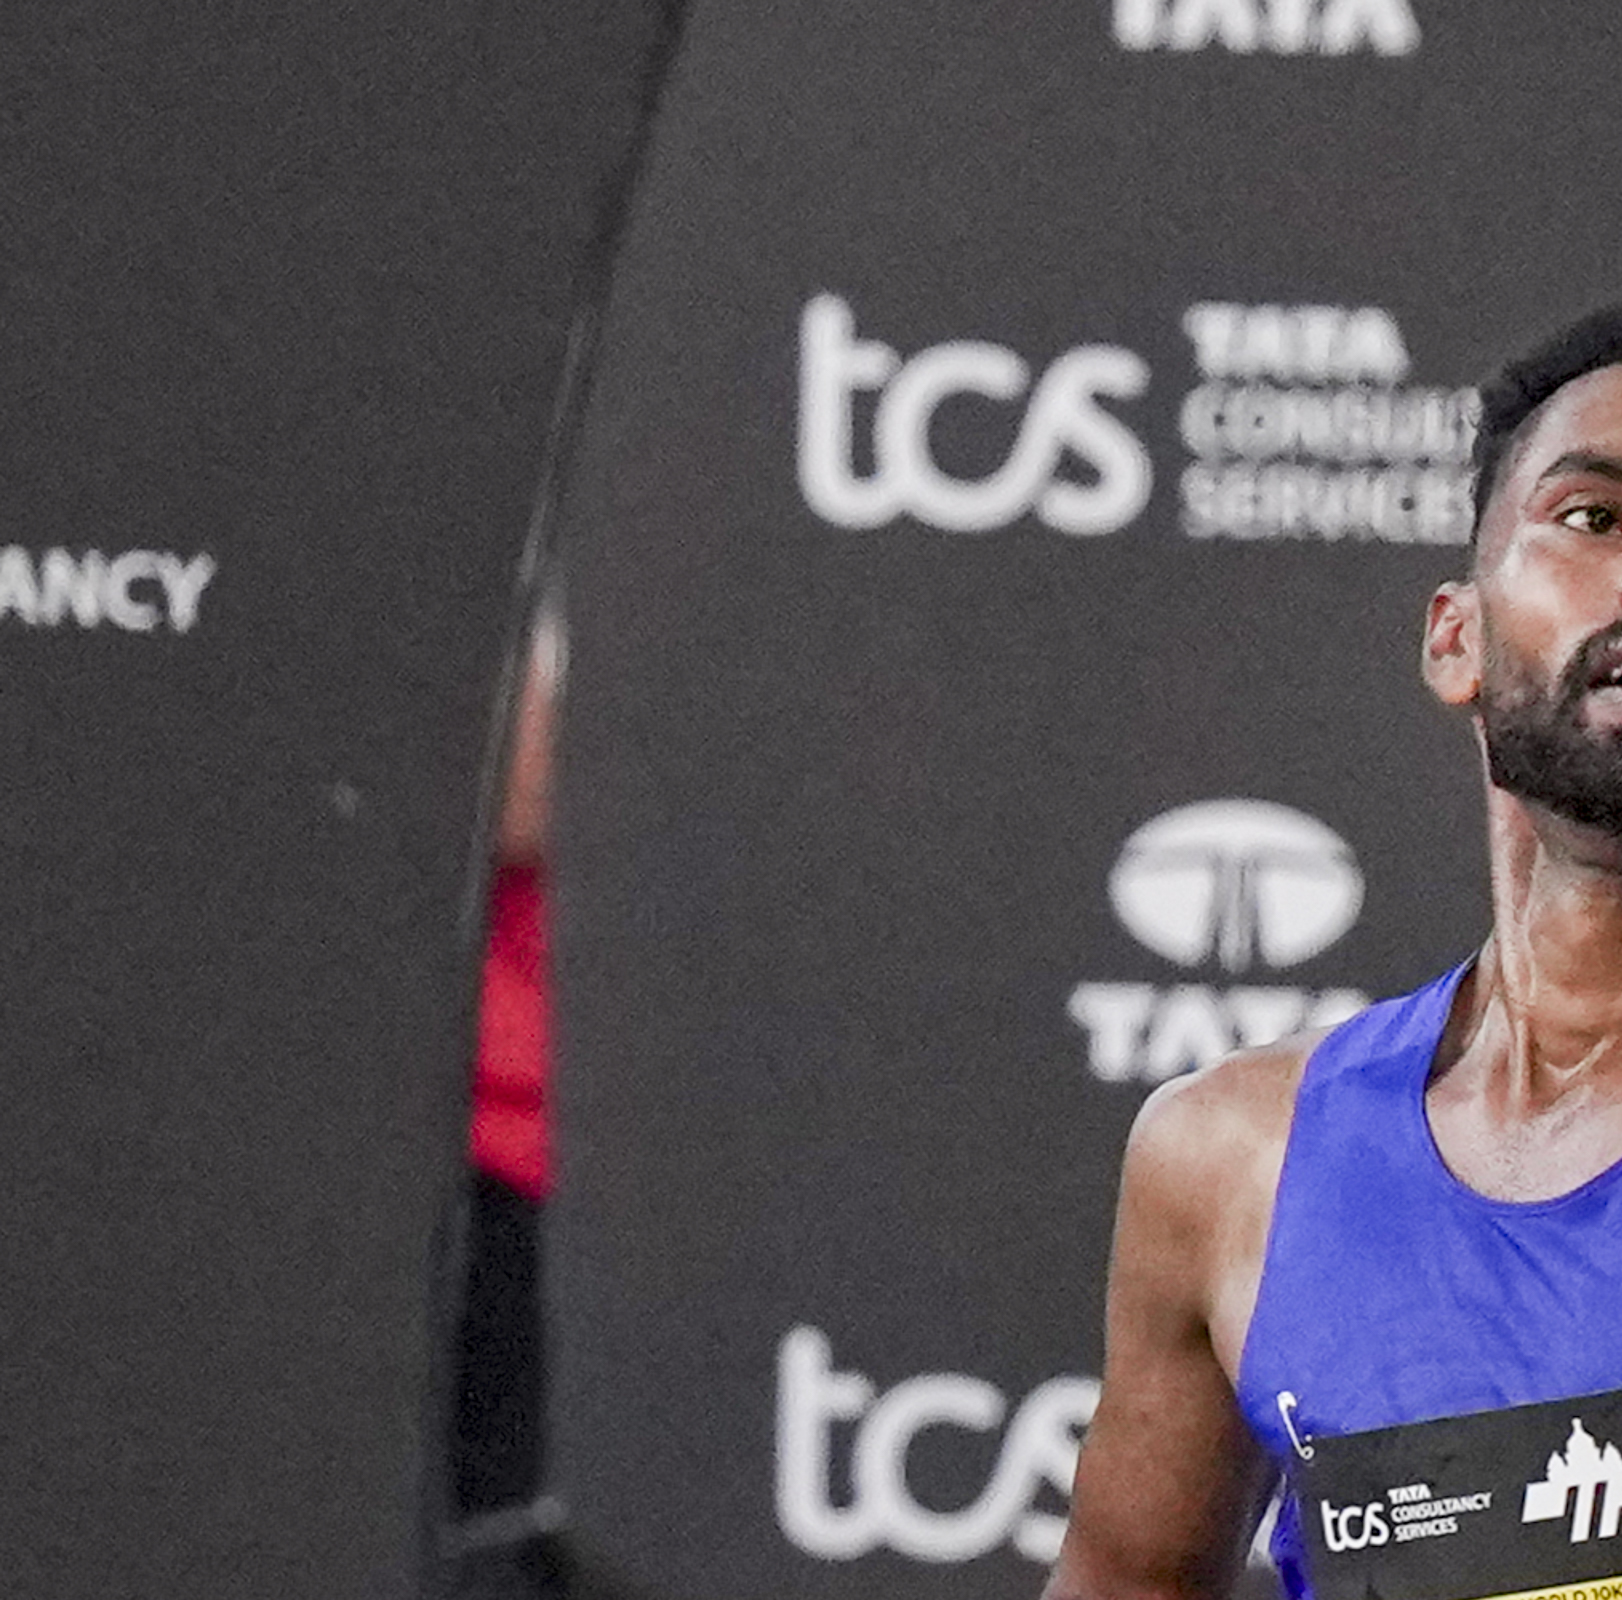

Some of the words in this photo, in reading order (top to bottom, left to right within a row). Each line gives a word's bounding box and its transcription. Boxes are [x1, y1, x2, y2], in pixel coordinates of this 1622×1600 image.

[1183, 302, 1409, 380] TATA
[799, 292, 1153, 535] tcs
[1180, 463, 1477, 545] SERVICE
[774, 1322, 1105, 1562] tcs
[1321, 1499, 1390, 1552] tcs
[1387, 1483, 1432, 1505] TATA
[1390, 1491, 1493, 1523] CONSULTANCY
[1394, 1516, 1459, 1543] SERVICES
